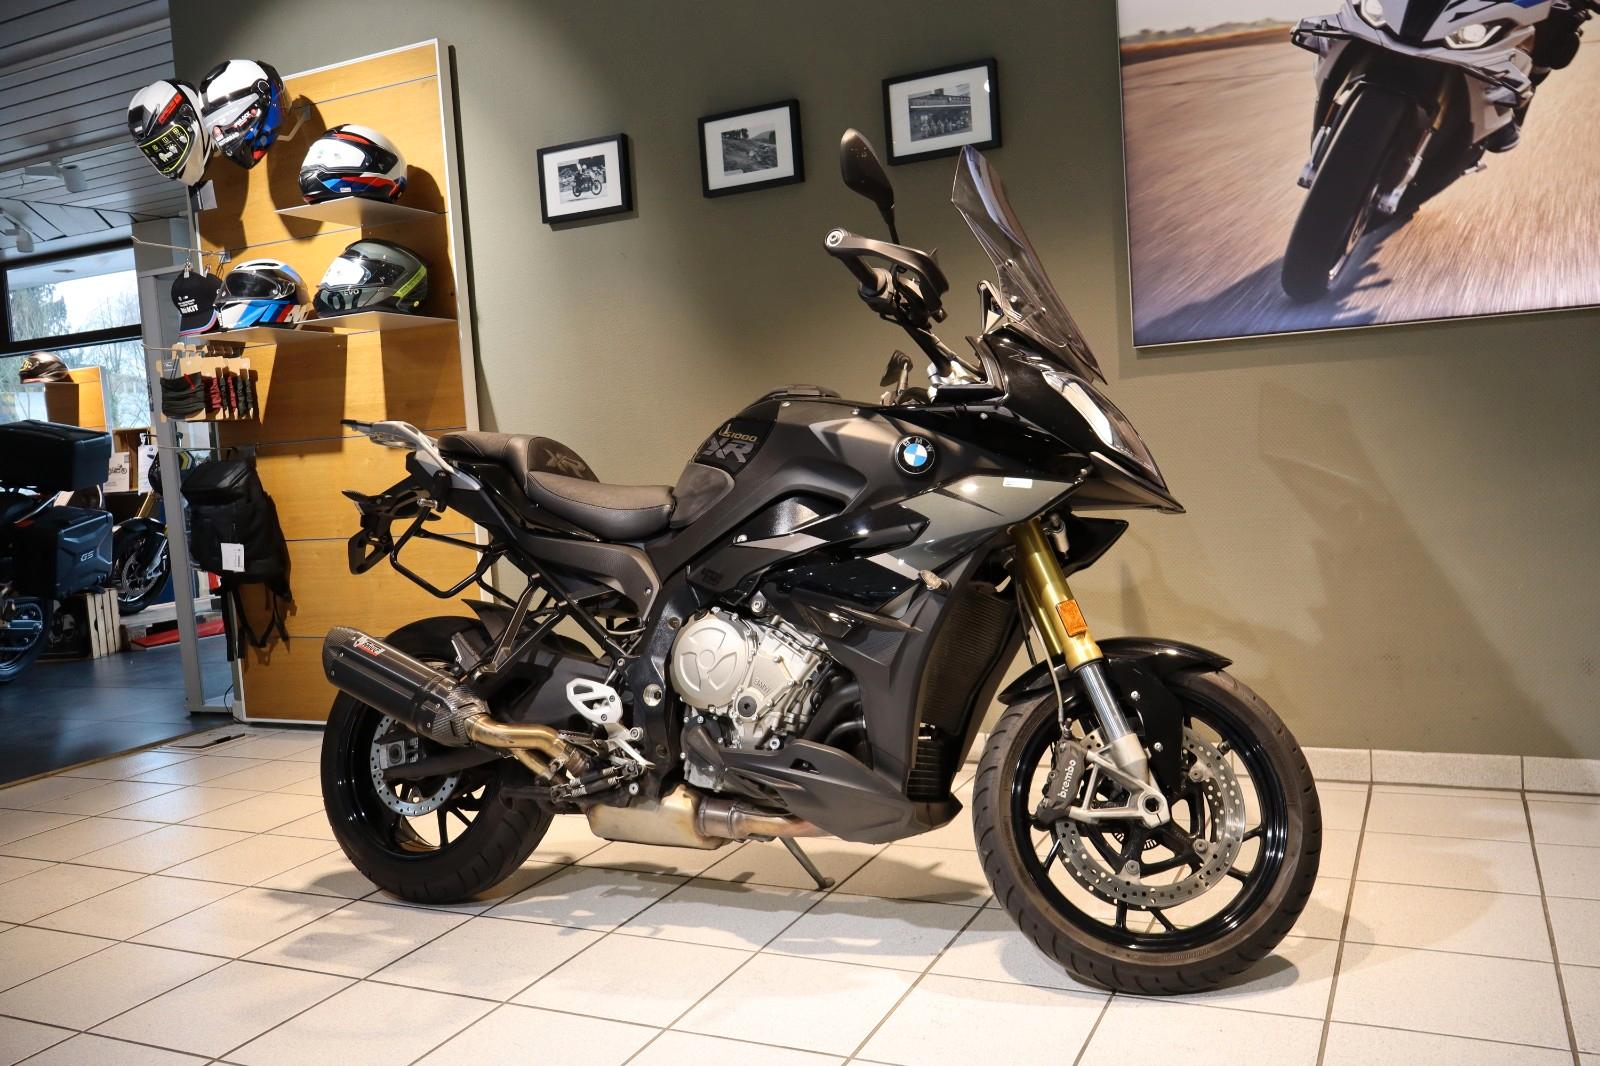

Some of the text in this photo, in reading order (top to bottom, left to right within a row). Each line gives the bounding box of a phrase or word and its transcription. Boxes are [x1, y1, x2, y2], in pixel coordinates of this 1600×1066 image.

[701, 437, 754, 463] XR
[902, 437, 934, 452] BMW
[81, 550, 94, 561] GS
[1057, 759, 1077, 798] brembo
